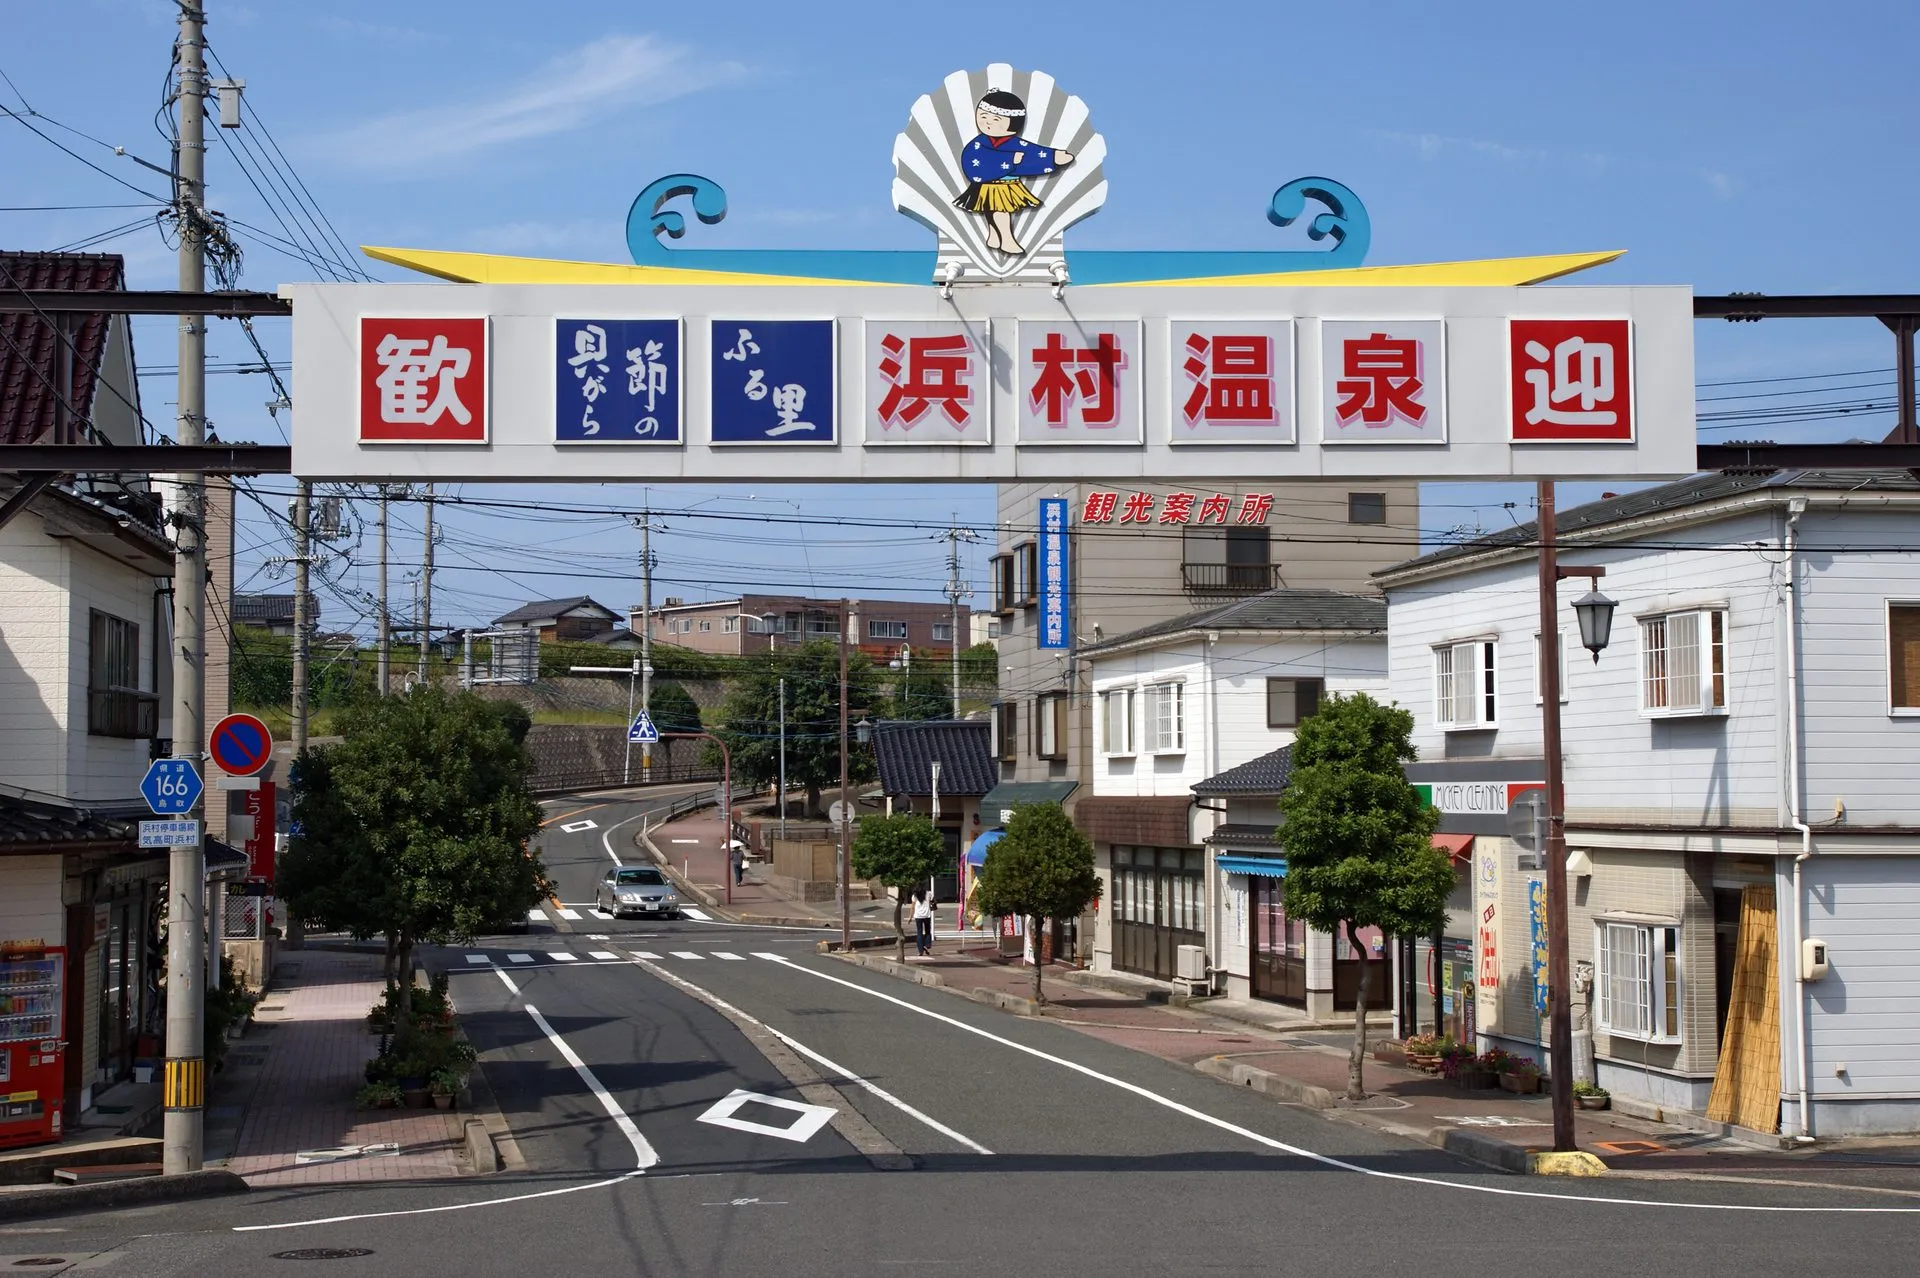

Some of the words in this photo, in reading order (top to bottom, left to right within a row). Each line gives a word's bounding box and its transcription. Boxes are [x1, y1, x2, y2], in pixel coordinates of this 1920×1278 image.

[375, 333, 473, 427] 歓
[567, 324, 609, 437] 貝がら
[625, 339, 668, 439] 節の
[722, 328, 817, 438] ふる里
[877, 332, 1426, 430] 浜村温泉
[1525, 336, 1617, 428] 迎
[1081, 491, 1274, 525] 観光案内所
[1046, 502, 1062, 645] 浜村温泉観光案内所
[155, 774, 188, 796] 166
[1466, 784, 1505, 811] CLEANING
[142, 834, 196, 845] 気高町浜村
